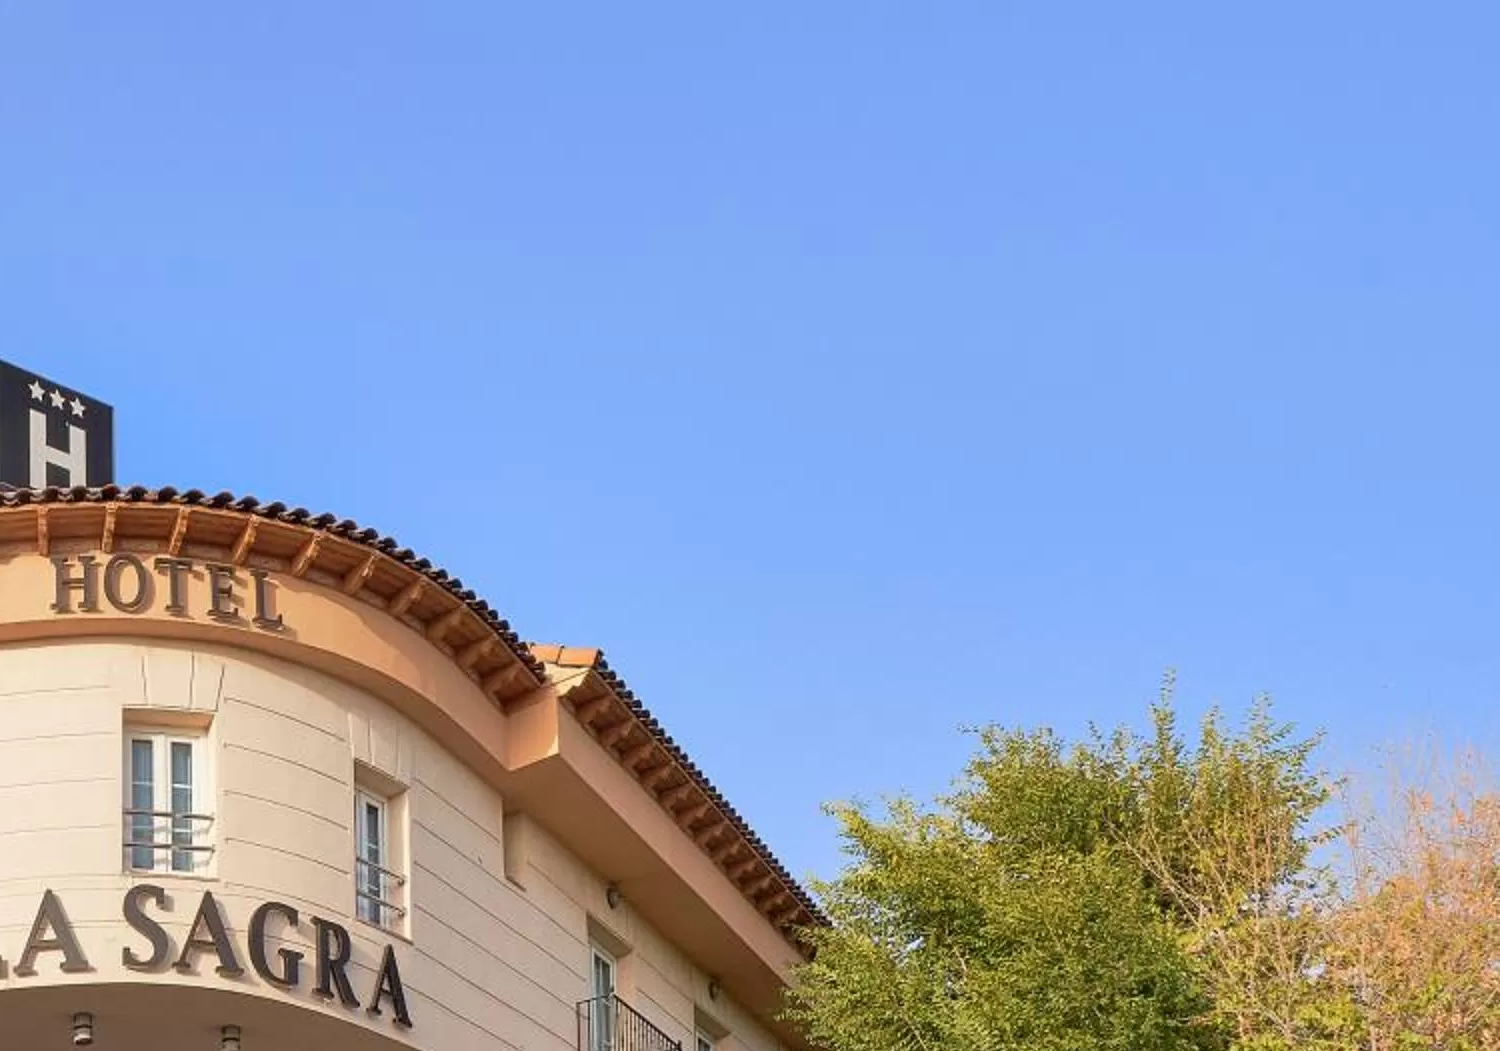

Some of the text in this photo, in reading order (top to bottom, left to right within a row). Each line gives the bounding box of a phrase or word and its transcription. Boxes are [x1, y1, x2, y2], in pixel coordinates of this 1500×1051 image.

[29, 407, 87, 488] H
[51, 552, 284, 630] HOTEL
[122, 883, 414, 1029] SAGRA
